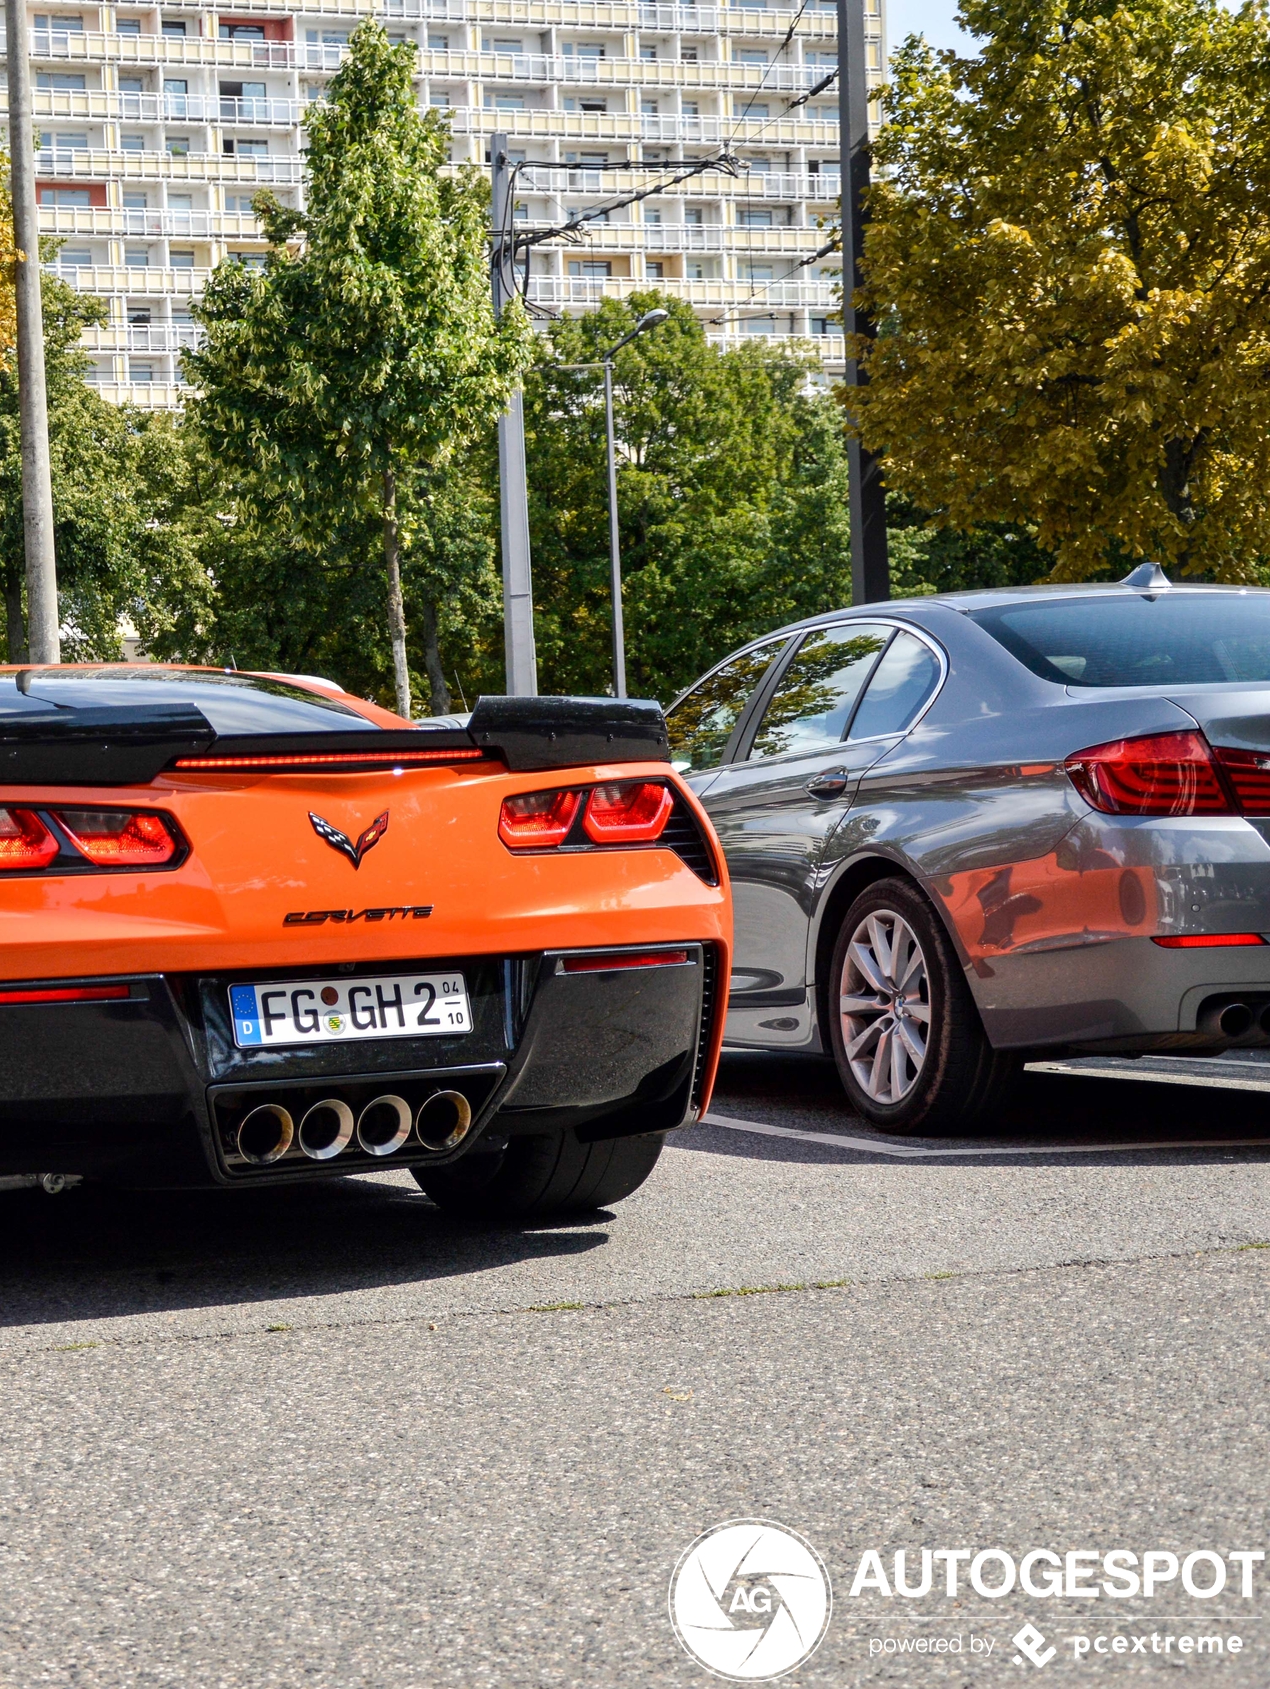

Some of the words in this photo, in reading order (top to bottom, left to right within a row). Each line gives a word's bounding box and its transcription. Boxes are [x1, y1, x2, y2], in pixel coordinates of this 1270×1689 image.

[283, 904, 434, 924] CORVETTE
[442, 981, 459, 994] 04
[242, 1021, 253, 1035] D
[261, 989, 320, 1036] FG
[348, 983, 406, 1030] GH
[414, 982, 440, 1026] 2
[447, 1011, 464, 1025] 10
